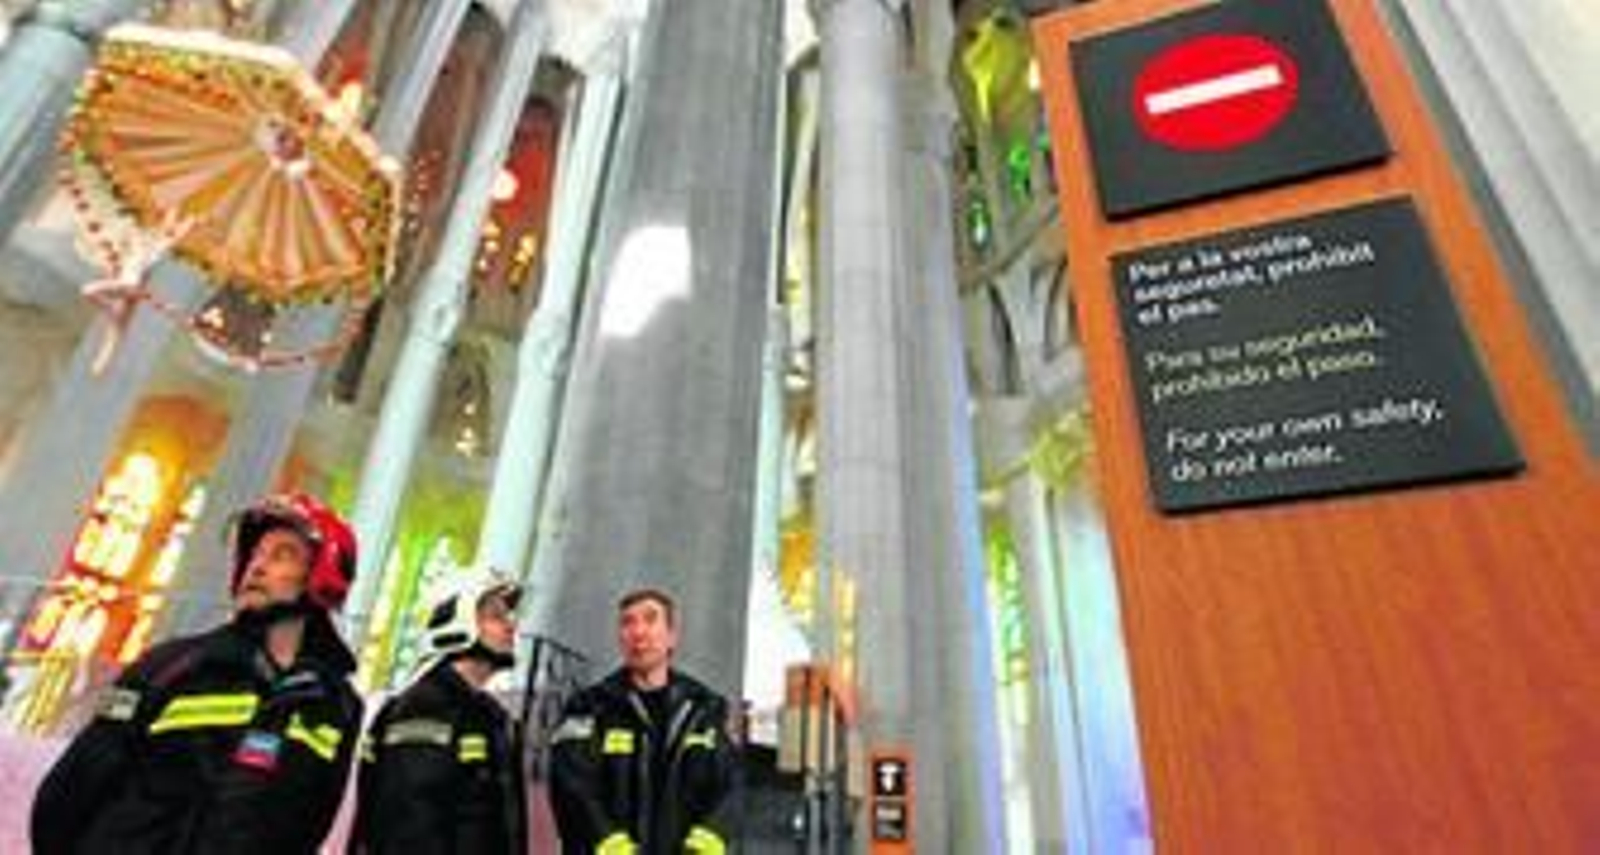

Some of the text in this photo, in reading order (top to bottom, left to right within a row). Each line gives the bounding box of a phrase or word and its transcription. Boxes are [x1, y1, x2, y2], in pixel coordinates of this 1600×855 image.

[1130, 234, 1312, 282] Per a la vostra
[1134, 242, 1374, 302] seguretat, prohibit
[1138, 301, 1219, 325] el pas.
[1146, 349, 1203, 373] Para
[1211, 342, 1240, 359] su
[1151, 366, 1269, 402] prohibido
[1276, 358, 1301, 380] el
[1167, 427, 1207, 454] For
[1216, 423, 1275, 450] your
[1282, 414, 1342, 436] own
[1171, 442, 1343, 482] do not enter.
